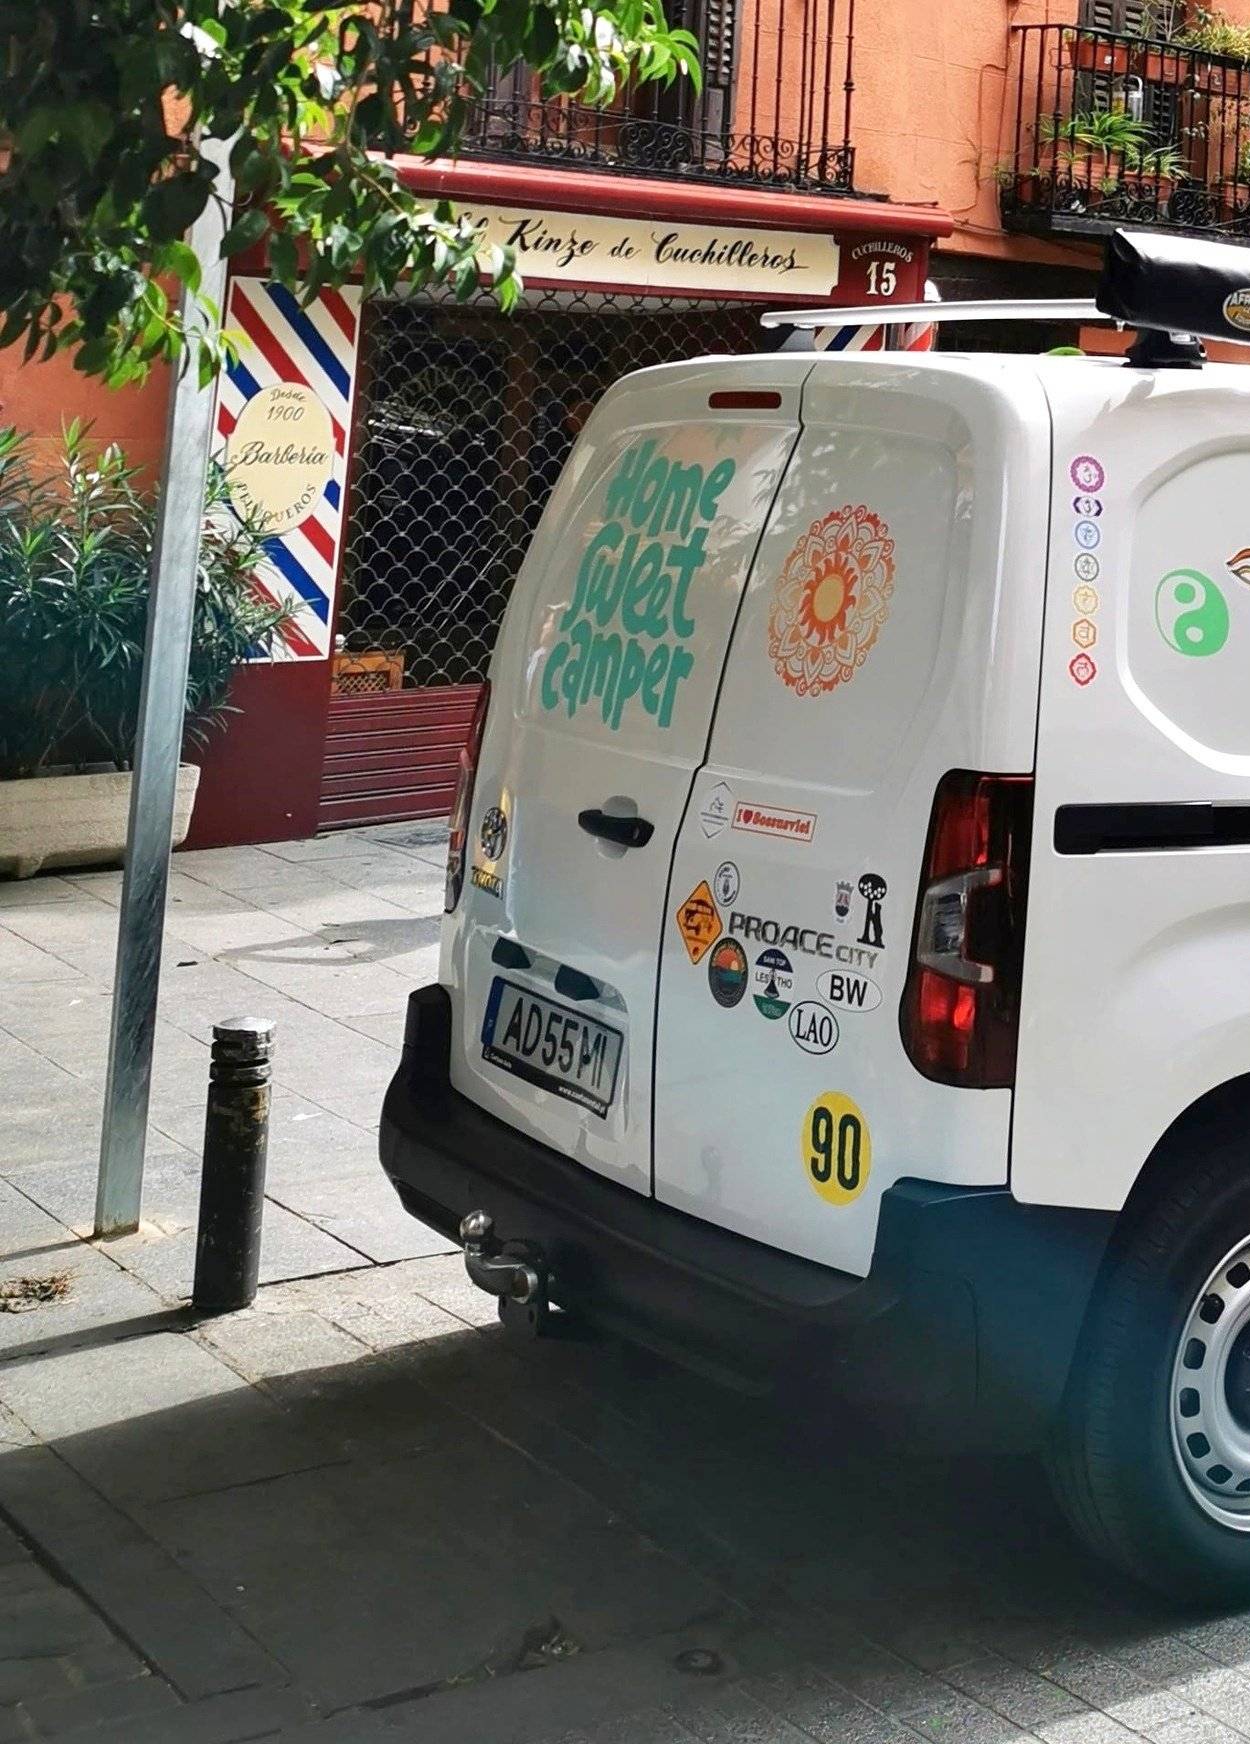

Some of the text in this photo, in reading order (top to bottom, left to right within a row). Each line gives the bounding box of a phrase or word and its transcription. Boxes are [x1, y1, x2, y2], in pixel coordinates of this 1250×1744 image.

[498, 215, 600, 268] Kinze
[610, 237, 641, 259] de
[651, 231, 809, 276] Cuchilleros
[866, 261, 897, 296] 15
[267, 405, 305, 422] 1900
[270, 388, 306, 402] Desde
[237, 482, 317, 525] PELQUEROS
[604, 438, 736, 541] Home
[560, 520, 710, 639] Sweet
[728, 911, 879, 969] PROACE CITY
[829, 974, 868, 1008] BW
[795, 1008, 833, 1047] LAO
[811, 1106, 861, 1190] 90
